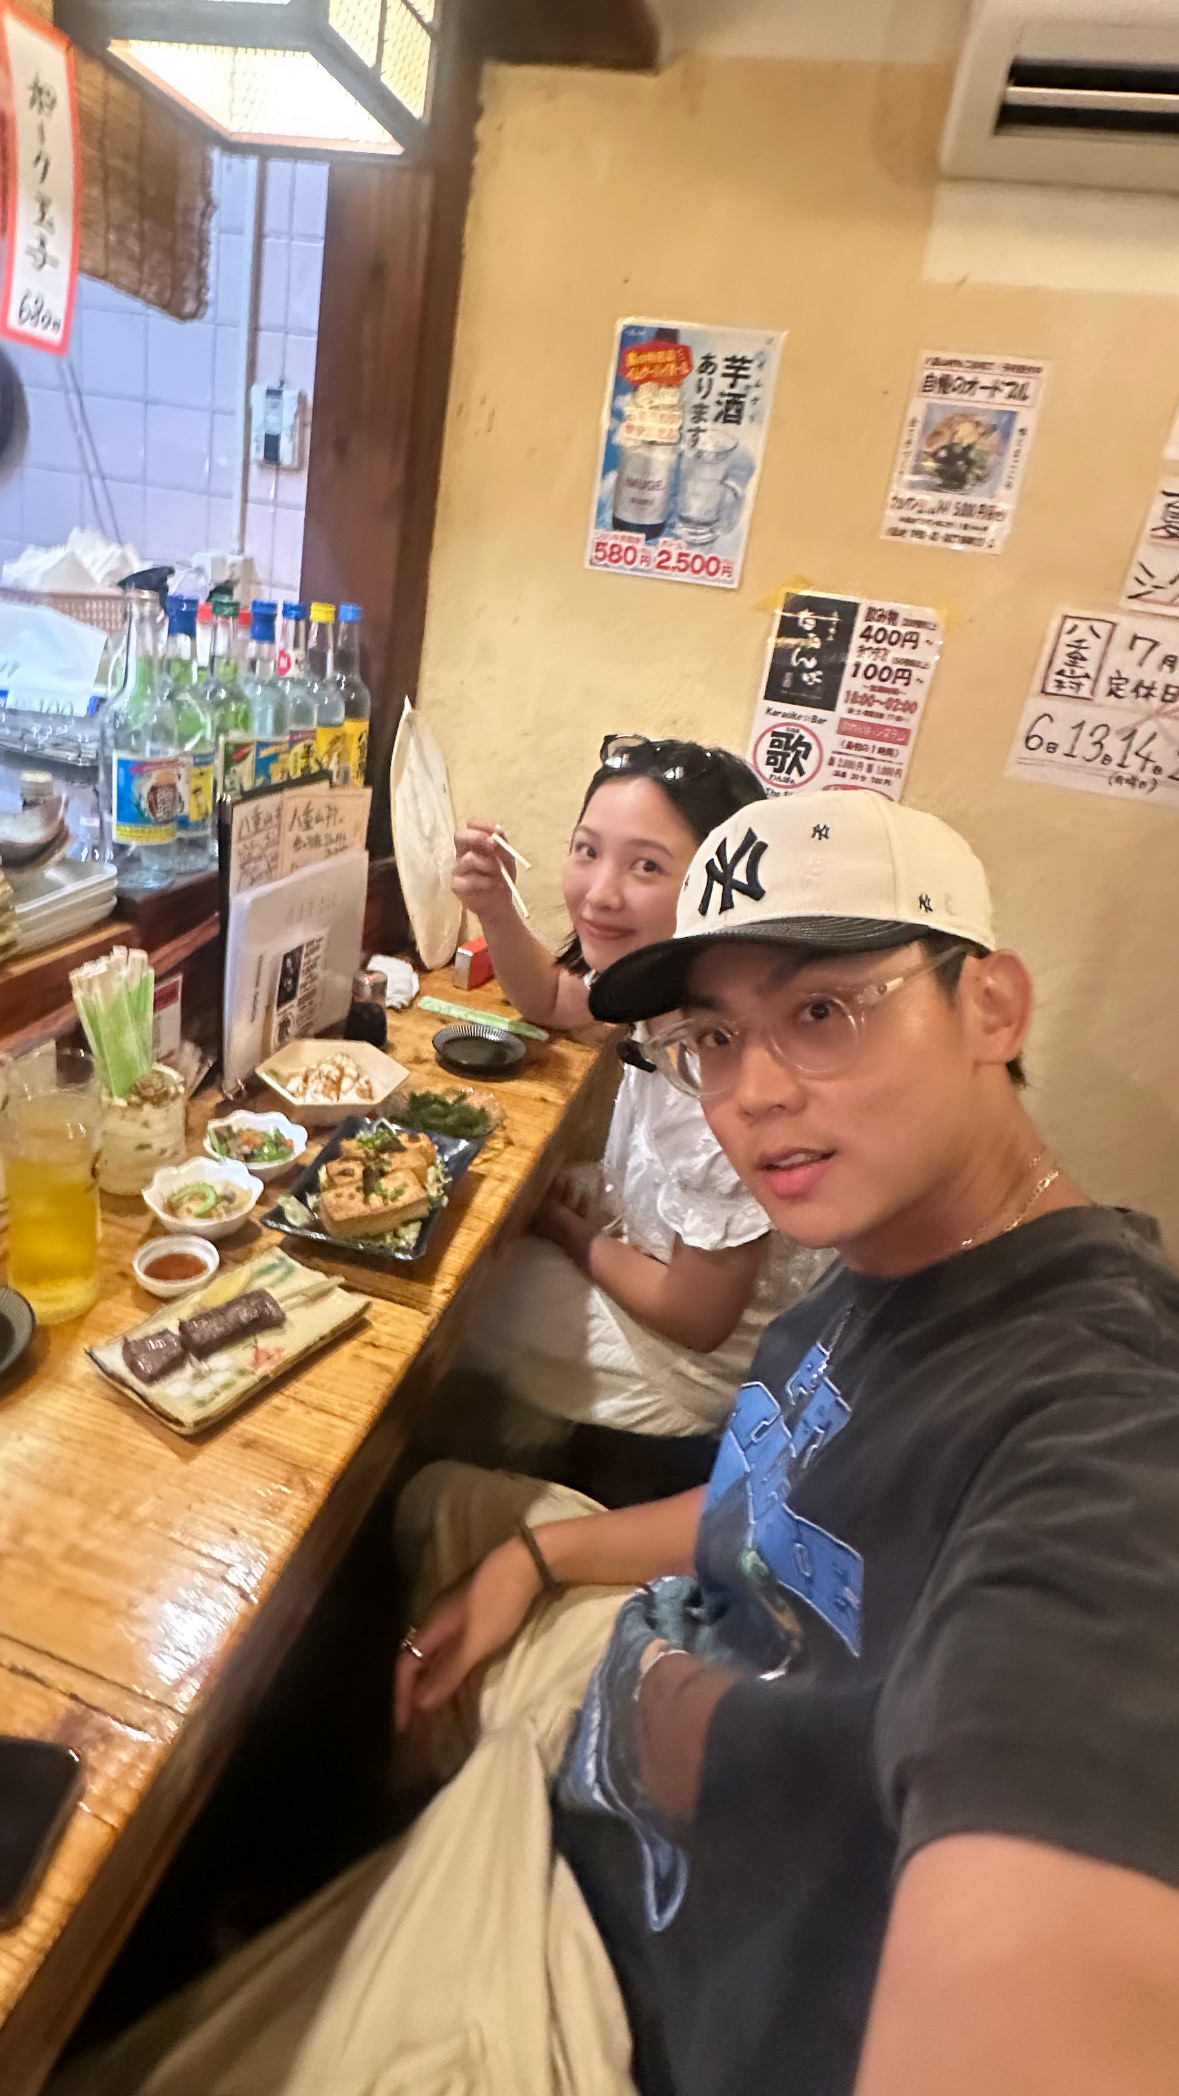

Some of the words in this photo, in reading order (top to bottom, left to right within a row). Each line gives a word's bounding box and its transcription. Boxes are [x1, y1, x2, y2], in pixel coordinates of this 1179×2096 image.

[713, 355, 755, 426] 芋酒
[594, 541, 651, 567] 580円
[859, 624, 920, 650] 400円
[1129, 633, 1179, 674] 7月
[851, 661, 913, 687] 100円
[1107, 669, 1179, 703] 定休日
[764, 730, 813, 778] 歌
[812, 823, 830, 840] NY
[698, 827, 769, 916] NY
[919, 894, 933, 913] NY
